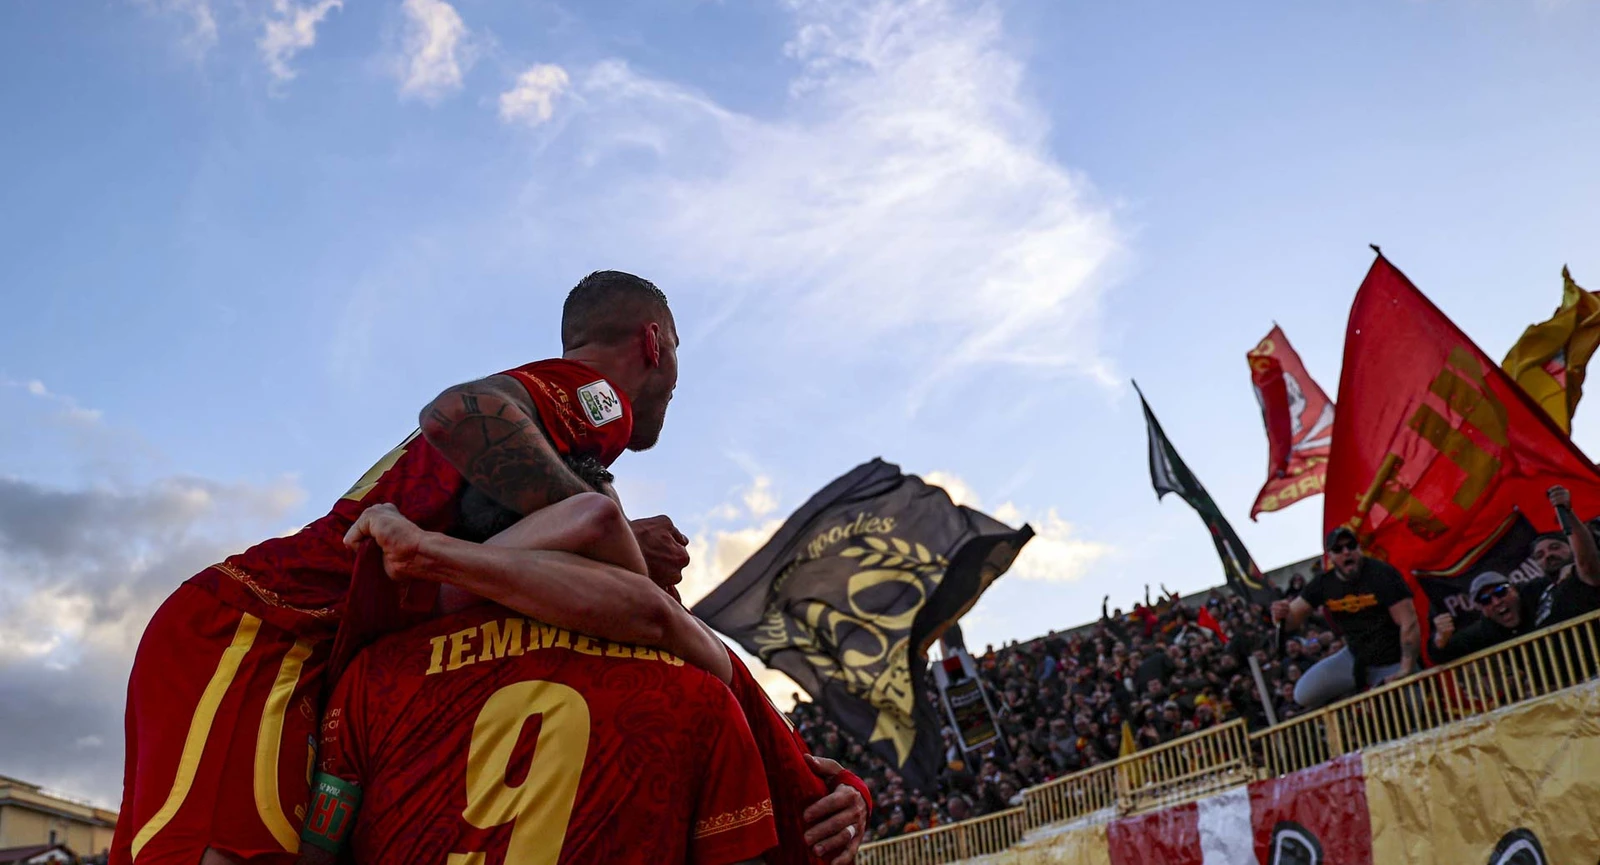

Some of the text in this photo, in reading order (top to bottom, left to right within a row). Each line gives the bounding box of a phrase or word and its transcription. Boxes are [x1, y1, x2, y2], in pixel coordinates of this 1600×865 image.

[807, 512, 897, 557] goodies
[425, 617, 685, 676] IEMME
[447, 680, 591, 865] 9
